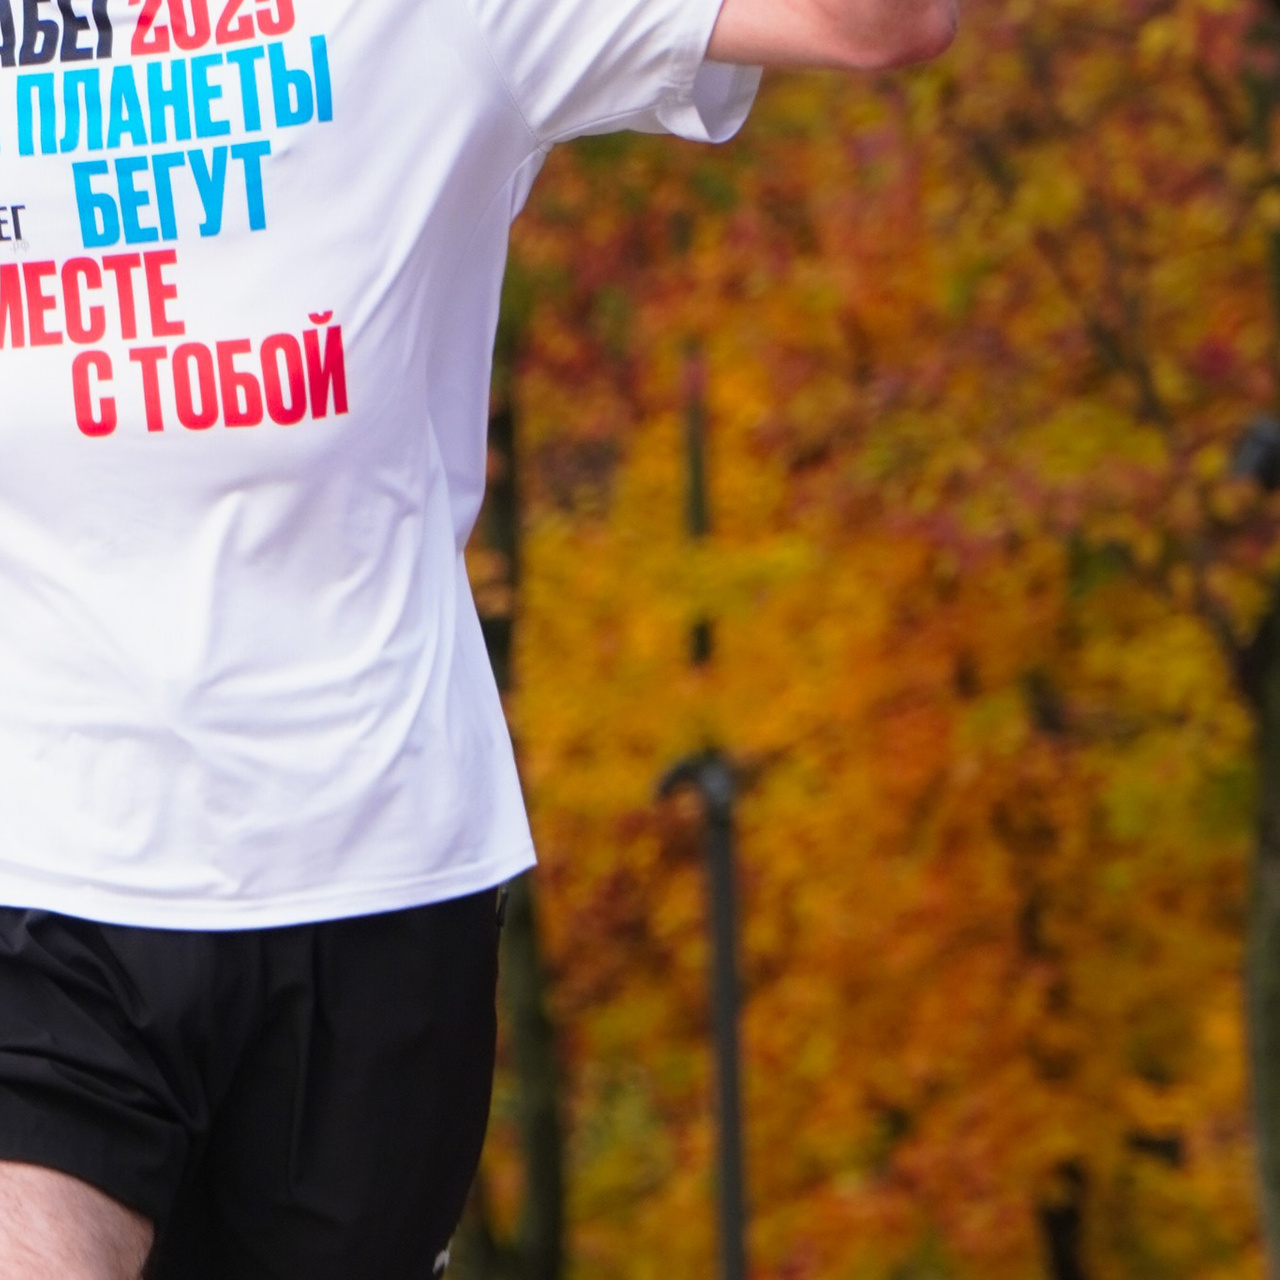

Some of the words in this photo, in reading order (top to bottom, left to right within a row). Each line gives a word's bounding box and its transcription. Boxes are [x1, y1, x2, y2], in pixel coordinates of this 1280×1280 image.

[15, 32, 334, 158] ПЛАНЕТЫ
[71, 138, 272, 250] БЕГУТ
[71, 350, 118, 439] С
[128, 309, 350, 434] ТОБОЙ
